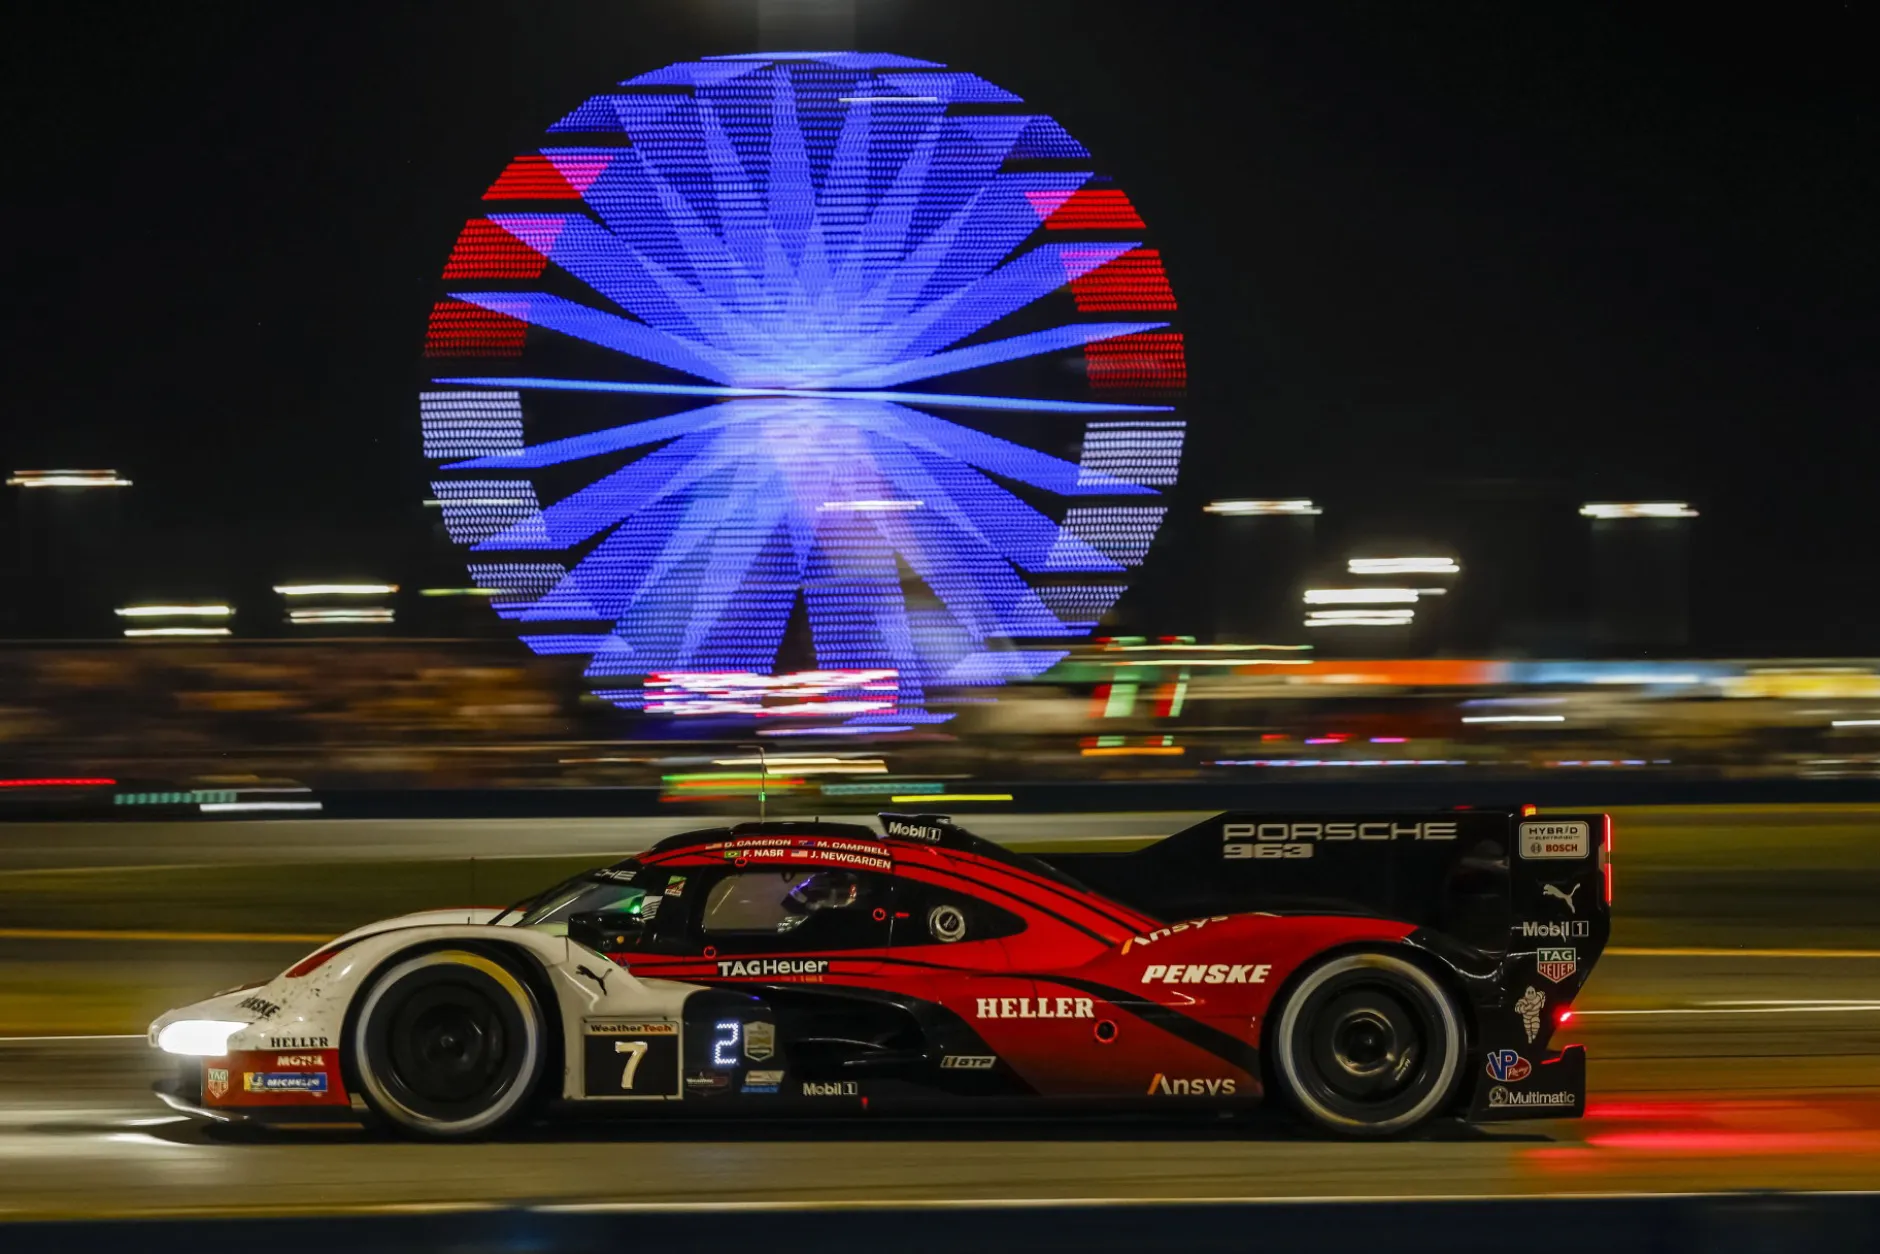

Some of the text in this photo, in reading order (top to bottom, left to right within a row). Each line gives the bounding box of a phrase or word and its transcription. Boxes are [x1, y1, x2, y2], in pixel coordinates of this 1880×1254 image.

[889, 822, 926, 839] Mobil
[1223, 822, 1457, 841] PORSCHE
[1529, 826, 1578, 835] HYBRID
[736, 839, 792, 847] CAMERON
[817, 841, 891, 856] M. CAMPBELL
[1223, 843, 1313, 859] 963
[1545, 844, 1578, 852] BOSCH
[743, 849, 784, 857] F. NASR
[811, 851, 891, 870] J. NEWGARDEN
[1522, 921, 1570, 937] Mobil
[1541, 950, 1573, 960] TAG
[1141, 964, 1272, 983] PENSKE
[1540, 963, 1574, 980] HEUER
[976, 998, 1094, 1018] HELLER
[591, 1024, 672, 1033] WeatherTech
[270, 1036, 329, 1048] HELLER
[713, 1022, 739, 1065] 2
[614, 1041, 648, 1090] 7
[958, 1058, 992, 1067] GTP
[1486, 1049, 1519, 1082] VP
[803, 1082, 842, 1096] Mobil
[1147, 1073, 1236, 1096] Ansys
[1509, 1091, 1575, 1105] Multimatic
